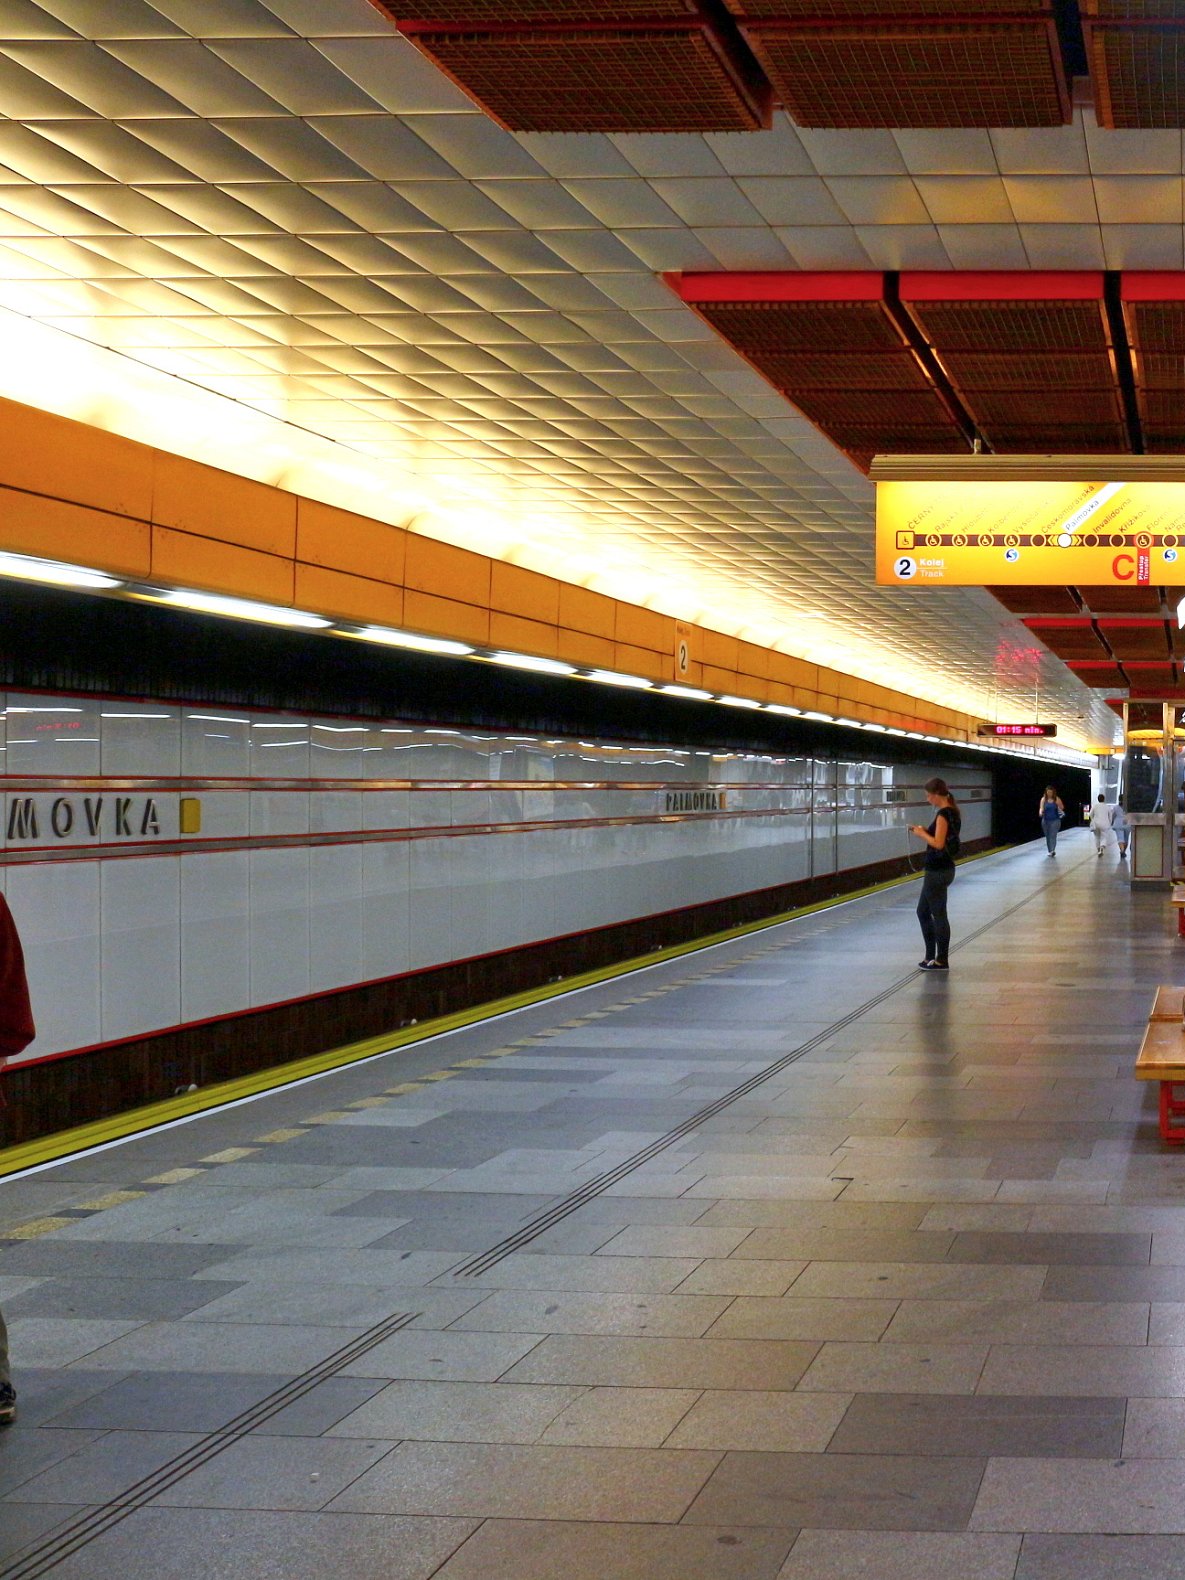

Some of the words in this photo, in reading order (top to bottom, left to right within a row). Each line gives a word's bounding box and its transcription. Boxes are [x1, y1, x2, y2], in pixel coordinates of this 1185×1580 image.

[1066, 499, 1098, 530] Palmovka
[1094, 498, 1130, 532] Invalidovna
[1147, 507, 1172, 530] Floren
[899, 559, 911, 575] 2
[919, 559, 944, 568] Kolej
[920, 569, 944, 577] Track
[1112, 554, 1134, 580] C
[680, 645, 686, 670] 2
[666, 792, 717, 811] PALMOVKA
[7, 797, 161, 839] MOVKA
